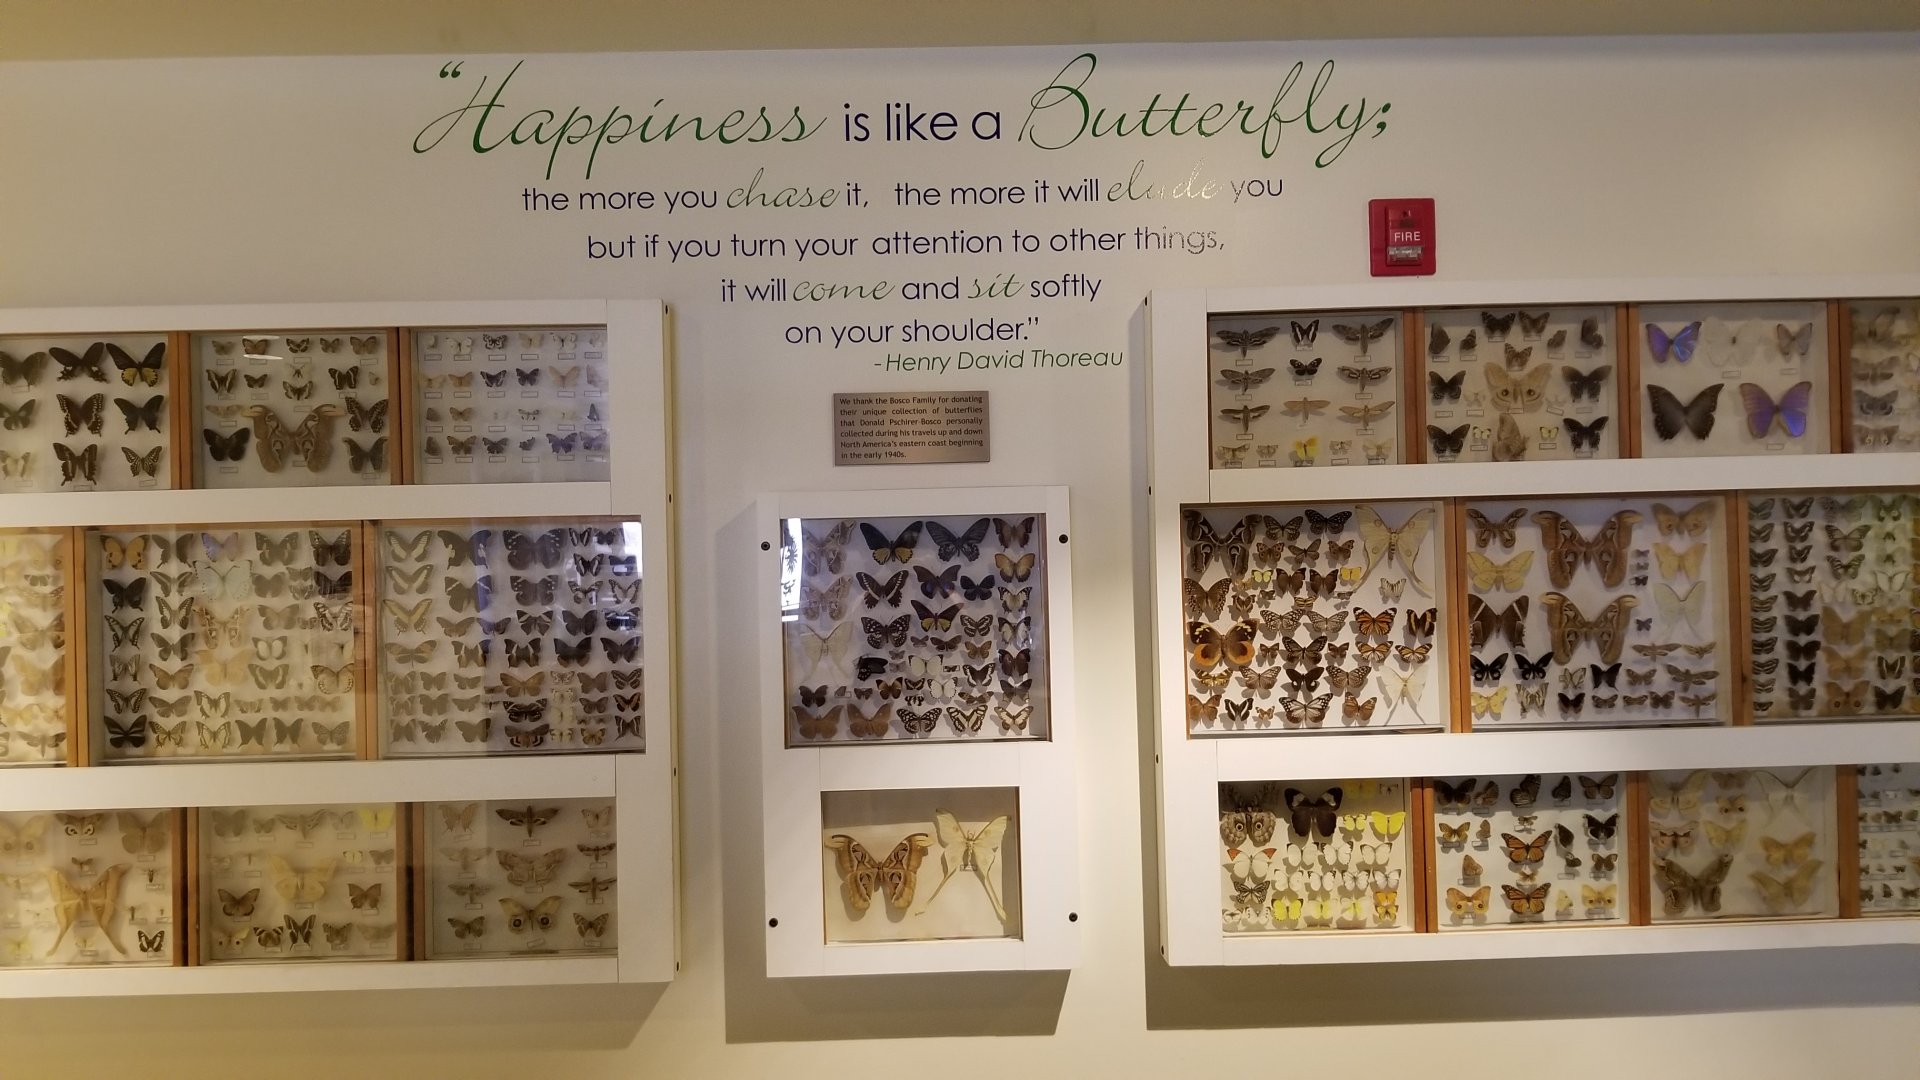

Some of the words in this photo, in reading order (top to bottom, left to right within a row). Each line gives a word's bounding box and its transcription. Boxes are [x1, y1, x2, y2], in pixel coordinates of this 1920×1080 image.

[413, 60, 827, 181] “Happiness
[843, 103, 871, 143] is
[885, 102, 959, 142] like
[971, 111, 1001, 141] a
[1018, 52, 1392, 169] Butterfly;
[521, 187, 570, 212] the
[579, 191, 656, 211] more
[663, 190, 718, 215] you
[726, 166, 841, 209] chase
[846, 182, 869, 209] it,
[893, 182, 942, 206] the
[950, 186, 1026, 206] more
[1034, 179, 1050, 204] it
[1057, 178, 1099, 203] will
[1230, 178, 1283, 204] you
[1394, 231, 1421, 242] FIRE
[587, 235, 637, 260] but
[645, 233, 660, 259] if
[667, 239, 721, 264] you
[730, 233, 786, 258] turn
[794, 238, 859, 263] your
[871, 230, 1003, 256] attention
[1011, 229, 1041, 253] to
[1049, 227, 1127, 253] other
[1133, 225, 1225, 255] things,
[721, 278, 737, 303] it
[744, 277, 787, 303] will
[792, 279, 896, 303] come
[901, 275, 960, 301] and
[967, 273, 1026, 301] sit
[1030, 273, 1102, 303] softly
[784, 325, 822, 344] on
[830, 324, 895, 350] your
[901, 316, 1040, 344] shoulder.”
[957, 349, 1025, 370] David
[1030, 348, 1123, 368] Thoreau
[853, 397, 873, 405] thank
[912, 396, 936, 404] Family
[938, 396, 949, 404] for
[951, 395, 982, 404] donating
[862, 408, 887, 416] unique
[891, 407, 928, 415] collection
[944, 406, 983, 414] butterflies
[946, 416, 983, 425] personally
[840, 430, 874, 438] collected
[875, 430, 898, 438] during
[911, 428, 937, 436] travels
[948, 428, 962, 436] and
[927, 439, 947, 447] coast
[948, 438, 984, 448] beginning
[850, 451, 862, 459] the
[863, 451, 882, 460] early
[884, 450, 907, 458] 1940s.
